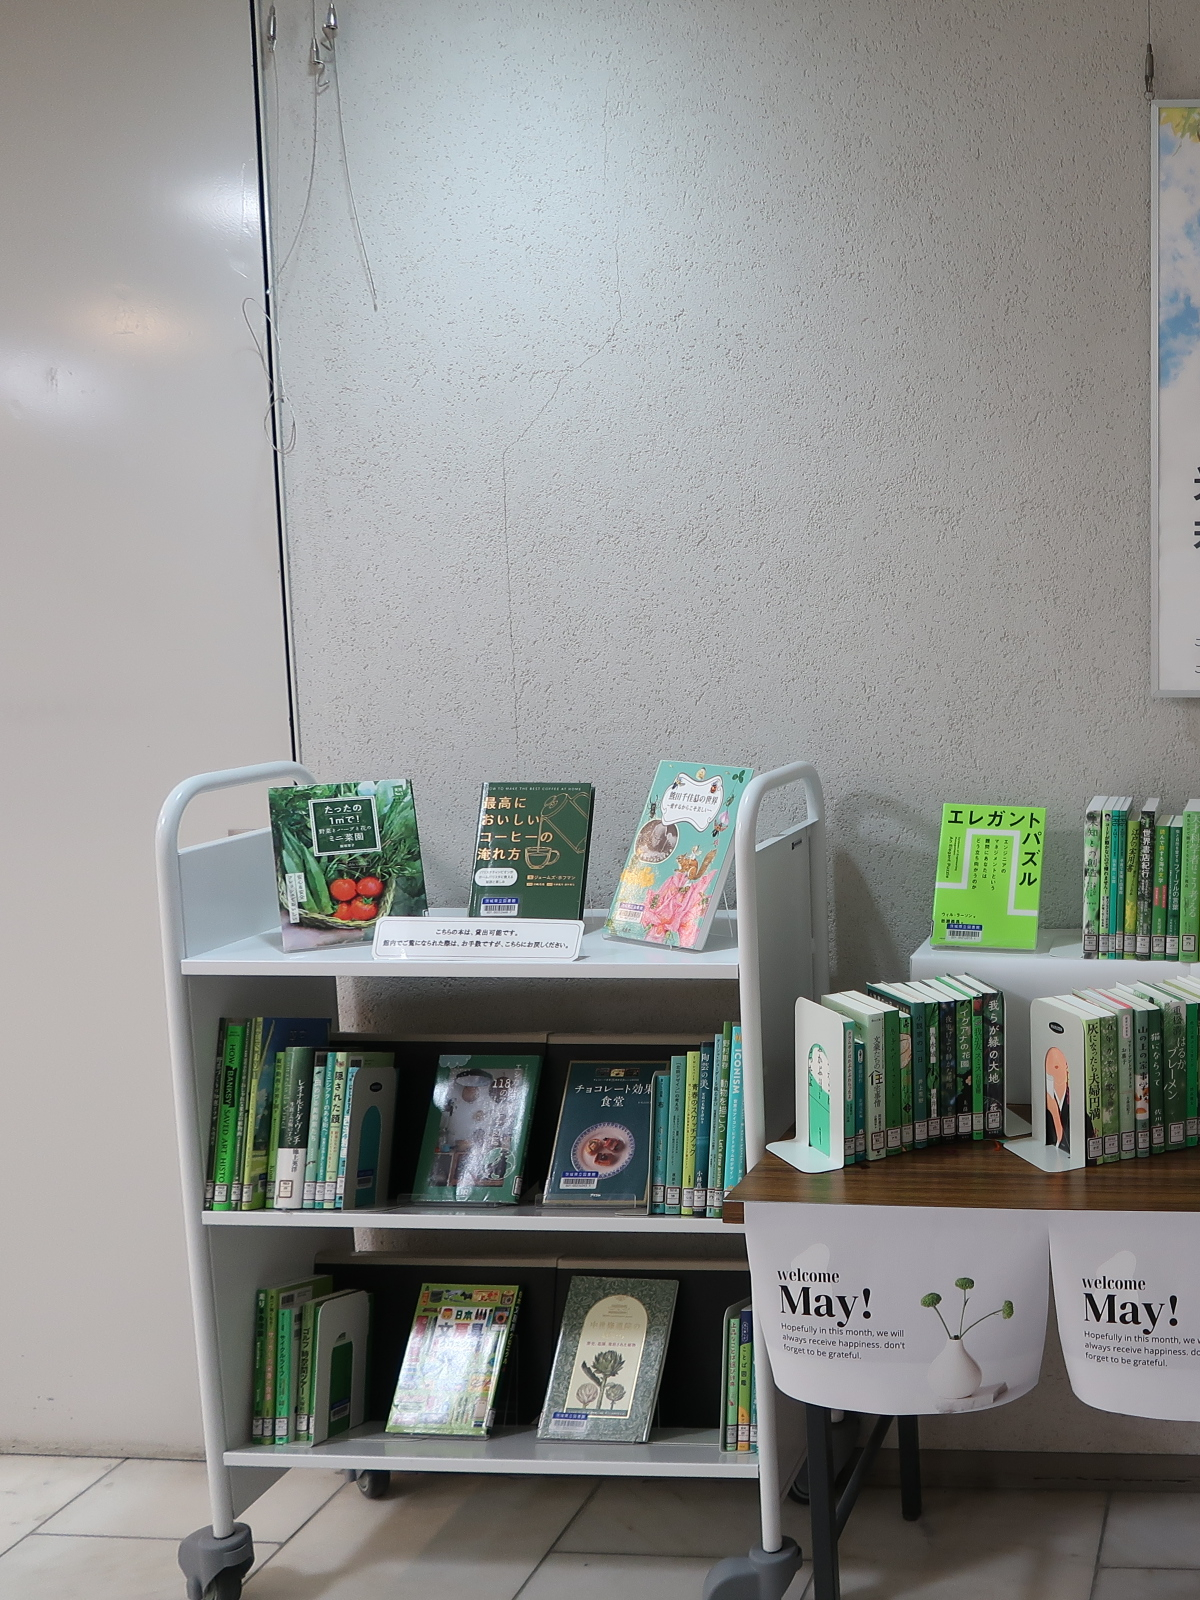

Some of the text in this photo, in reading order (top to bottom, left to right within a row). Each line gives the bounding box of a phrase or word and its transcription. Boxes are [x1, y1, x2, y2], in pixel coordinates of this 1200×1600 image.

[324, 804, 362, 814] たったの
[484, 796, 526, 810] 最高に
[482, 814, 540, 826] おいしい
[948, 810, 1040, 828] エレガント
[329, 832, 364, 842] ミニ菜園
[480, 831, 553, 842] コーヒーの
[477, 848, 522, 860] 淹れ方
[1019, 832, 1042, 886] パズル
[436, 928, 518, 936] こちらの本は、貸出可能です。
[959, 1008, 971, 1068] イグアナの花園
[988, 1000, 1000, 1083] 我らが緑の大地
[228, 1045, 236, 1064] HOW
[733, 1049, 742, 1094] ICONISM
[1087, 1023, 1101, 1120] 灰になったら夫婦円満
[1164, 1048, 1178, 1100] ブレーメン
[224, 1070, 234, 1104] BANKSY
[601, 1096, 625, 1107] 食堂
[218, 1158, 227, 1183] HISTO
[778, 1268, 839, 1283] welcome
[1082, 1276, 1145, 1290] welcome
[779, 1285, 871, 1327] May!
[455, 1310, 473, 1321] 日本
[1083, 1293, 1178, 1335] May!
[781, 1323, 817, 1335] Hopefully
[846, 1329, 874, 1337] month,
[1085, 1331, 1122, 1343] Hopefully
[1152, 1336, 1180, 1344] month,
[783, 1334, 806, 1344] always
[839, 1339, 882, 1349] happiness.
[884, 1341, 905, 1349] don't
[1085, 1342, 1110, 1352] always
[1113, 1346, 1142, 1354] receive
[1144, 1347, 1188, 1356] happiness.
[784, 1344, 805, 1354] forget
[817, 1349, 826, 1357] be
[1086, 1352, 1109, 1362] forget
[1133, 1359, 1167, 1367] grateful.
